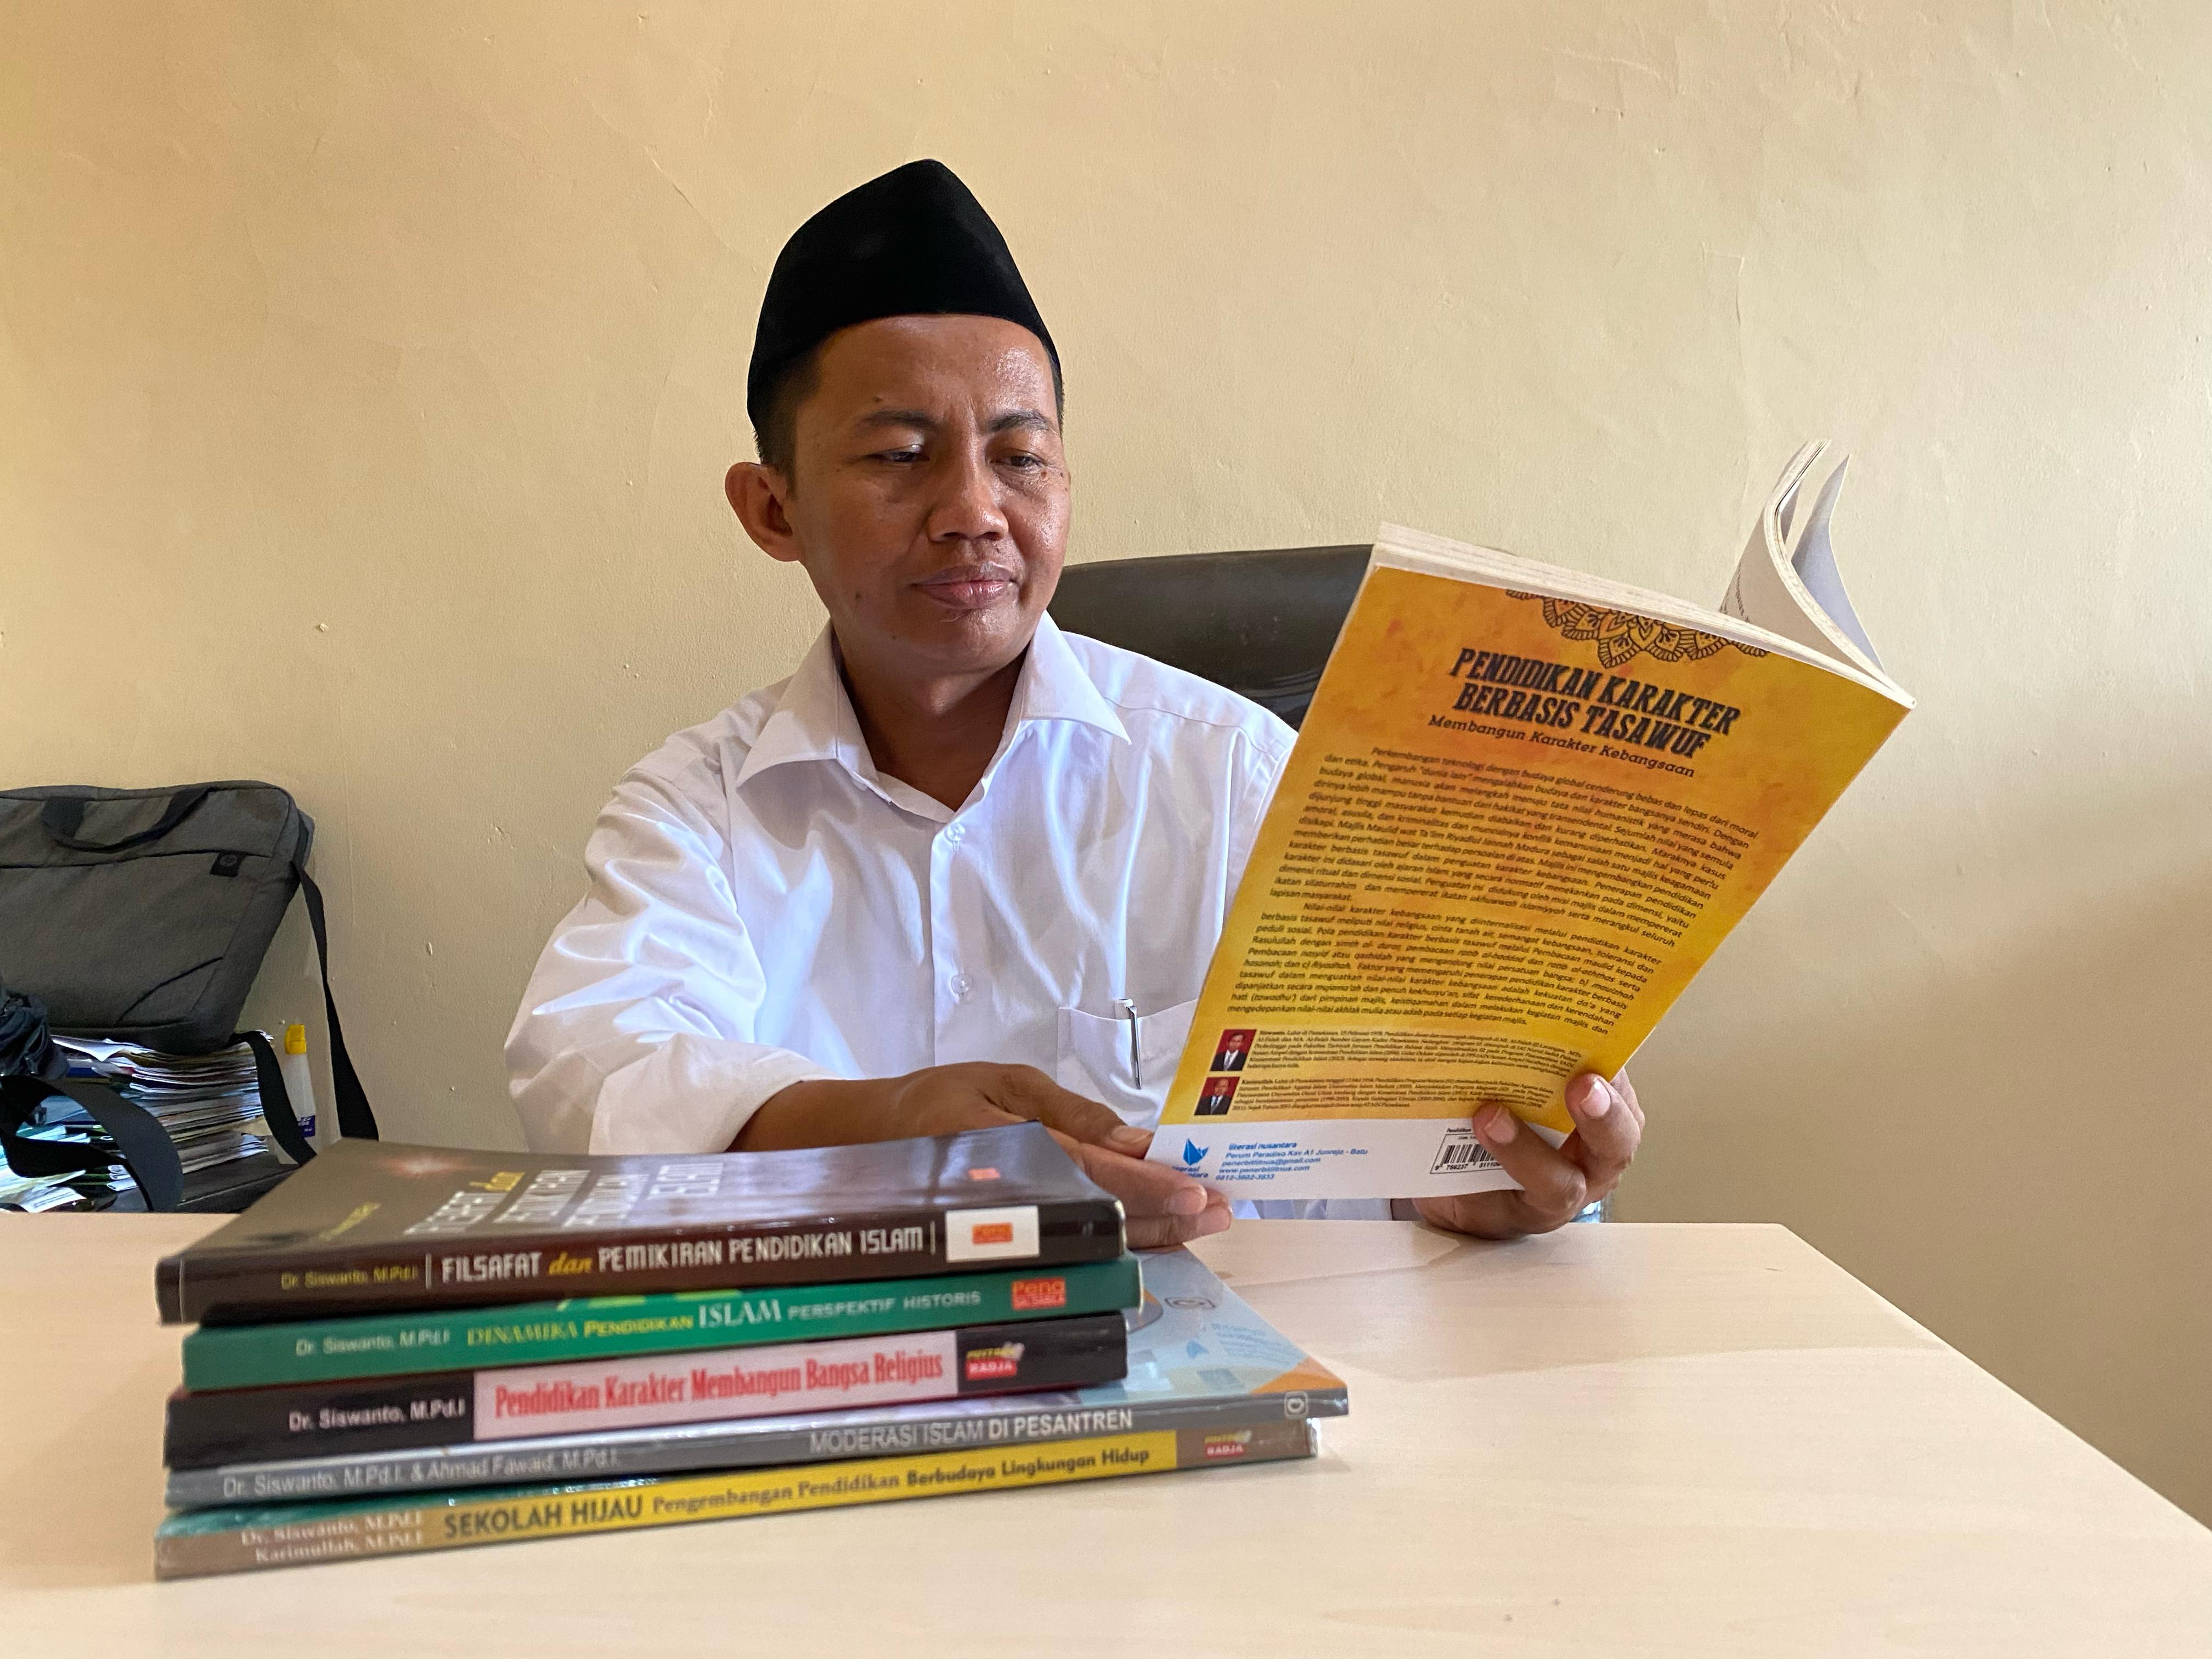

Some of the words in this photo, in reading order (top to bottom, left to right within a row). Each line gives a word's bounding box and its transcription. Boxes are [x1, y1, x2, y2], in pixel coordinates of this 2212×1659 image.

[1449, 647, 1599, 698] PENDIDIKAN
[1595, 676, 1741, 736] KARAKTER
[1452, 682, 1581, 730] BERBASIS
[1581, 704, 1711, 758] TASAWUF
[1428, 715, 1525, 741] Membangun
[1530, 731, 1596, 753] Karakter
[1599, 744, 1695, 777] Kebangsaan
[442, 1252, 541, 1283] FILSAFAT
[548, 1252, 592, 1275] dan
[599, 1240, 722, 1272] PEMIKIRAN
[729, 1231, 851, 1262] PENDIDIKAN
[860, 1227, 922, 1254] ISLAM
[468, 1322, 577, 1345] DINAMIKA
[699, 1300, 782, 1329] ISLAM
[787, 1297, 895, 1319] PERSPEKTIF
[904, 1291, 980, 1310] HISTORIS
[289, 1412, 312, 1431] Dr.
[320, 1404, 404, 1429] Siswanto,
[496, 1380, 600, 1419] Pendidikan
[605, 1373, 686, 1408] Karakter
[692, 1366, 801, 1401] Membangun
[806, 1358, 870, 1391] Bangsa
[874, 1350, 943, 1385] Religius
[411, 1463, 425, 1481] &
[427, 1457, 486, 1481] Ahmad
[810, 1425, 917, 1454] MODERASI
[924, 1420, 984, 1443] ISLAM
[989, 1417, 1012, 1440] DI
[1014, 1409, 1132, 1437] PESANTREN
[445, 1501, 562, 1537] SEKOLAH
[571, 1495, 642, 1523] HIJAU
[652, 1483, 793, 1513] Pengembangan
[798, 1469, 899, 1498] Pendidikan
[907, 1463, 995, 1486] Berbudaya
[1001, 1452, 1095, 1478] Lingkungan
[1102, 1447, 1149, 1469] Hidup
